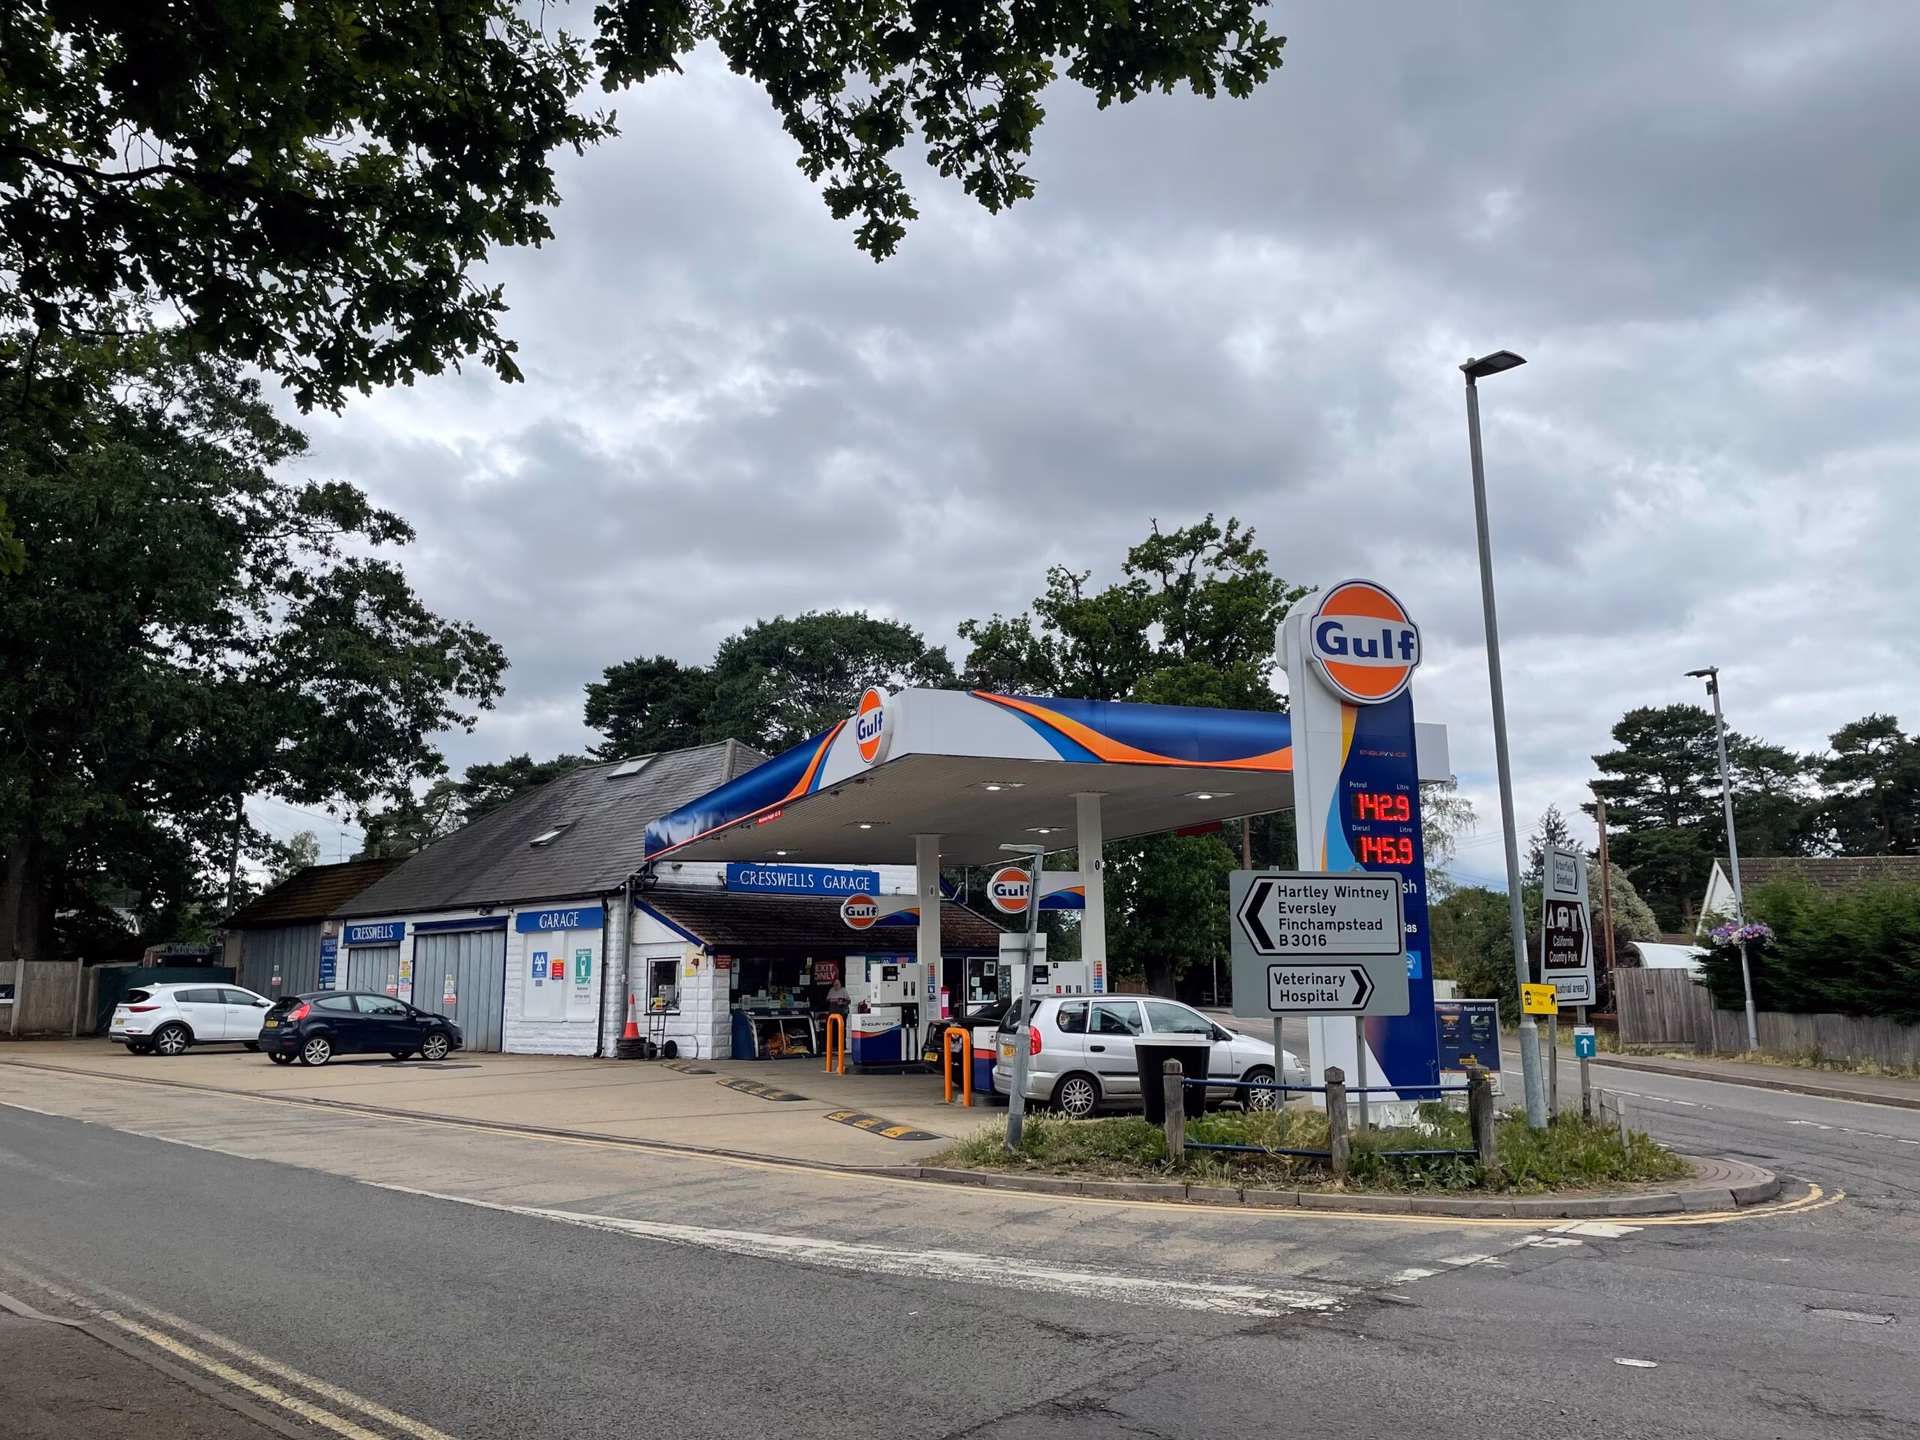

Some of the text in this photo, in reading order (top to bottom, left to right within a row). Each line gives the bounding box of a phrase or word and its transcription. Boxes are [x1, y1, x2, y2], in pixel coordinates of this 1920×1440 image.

[1316, 621, 1414, 660] Gulf
[858, 711, 883, 740] Gulf
[1357, 793, 1410, 821] 142.9
[1360, 836, 1413, 864] 145.9
[740, 870, 870, 890] CRESSWELLS GARAGE
[1402, 879, 1417, 894] sh
[1556, 873, 1573, 886] Shinfield
[1278, 885, 1389, 901] Hartley Wintney
[845, 907, 877, 916] Gulf
[1278, 901, 1336, 916] Eversley
[539, 912, 579, 928] GARAGE
[1279, 918, 1383, 933] Finchampstead
[351, 925, 394, 940] CRESSWELLS
[1552, 935, 1574, 947] California
[1549, 950, 1578, 964] Country Park
[815, 963, 834, 972] EXIT
[1273, 972, 1346, 987] Veterinary
[1557, 983, 1585, 994] ustrial areas
[1280, 989, 1339, 1004] Hospital
